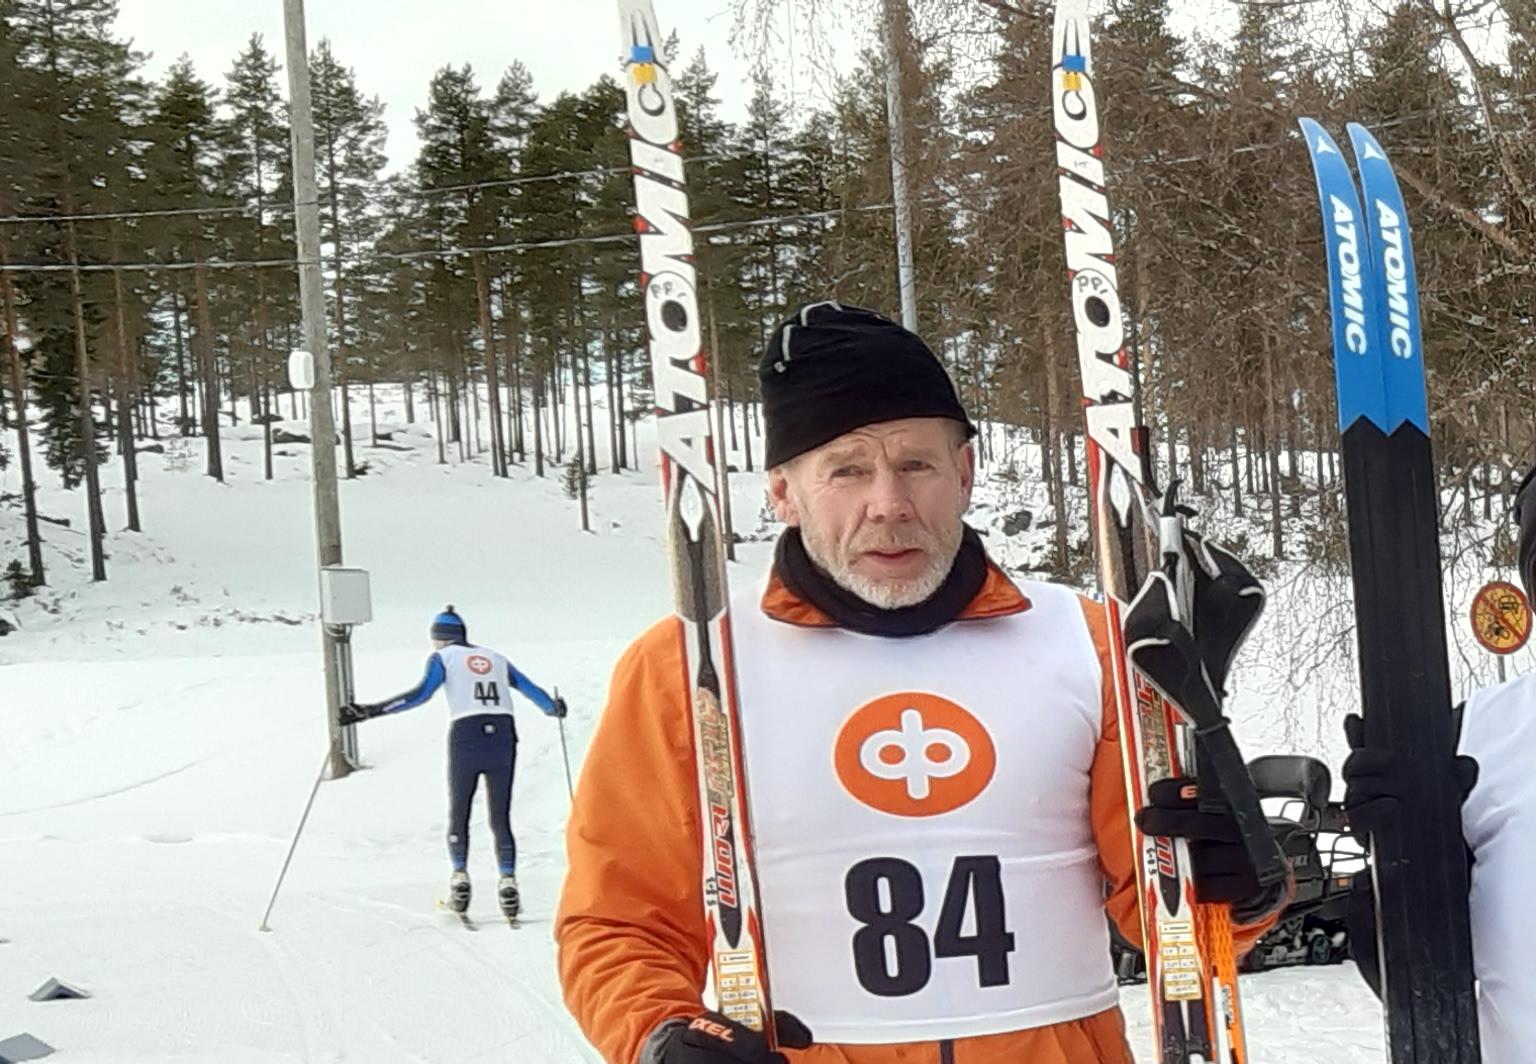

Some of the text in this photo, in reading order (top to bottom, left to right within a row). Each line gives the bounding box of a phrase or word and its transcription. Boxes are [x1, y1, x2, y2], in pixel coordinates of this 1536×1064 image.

[626, 56, 717, 497] ATOMIC
[1053, 66, 1142, 493] ATOMIC
[1329, 193, 1367, 356] ATOMIC
[1375, 199, 1412, 361] ATOMIC
[473, 680, 500, 706] 44
[844, 853, 1016, 998] 84
